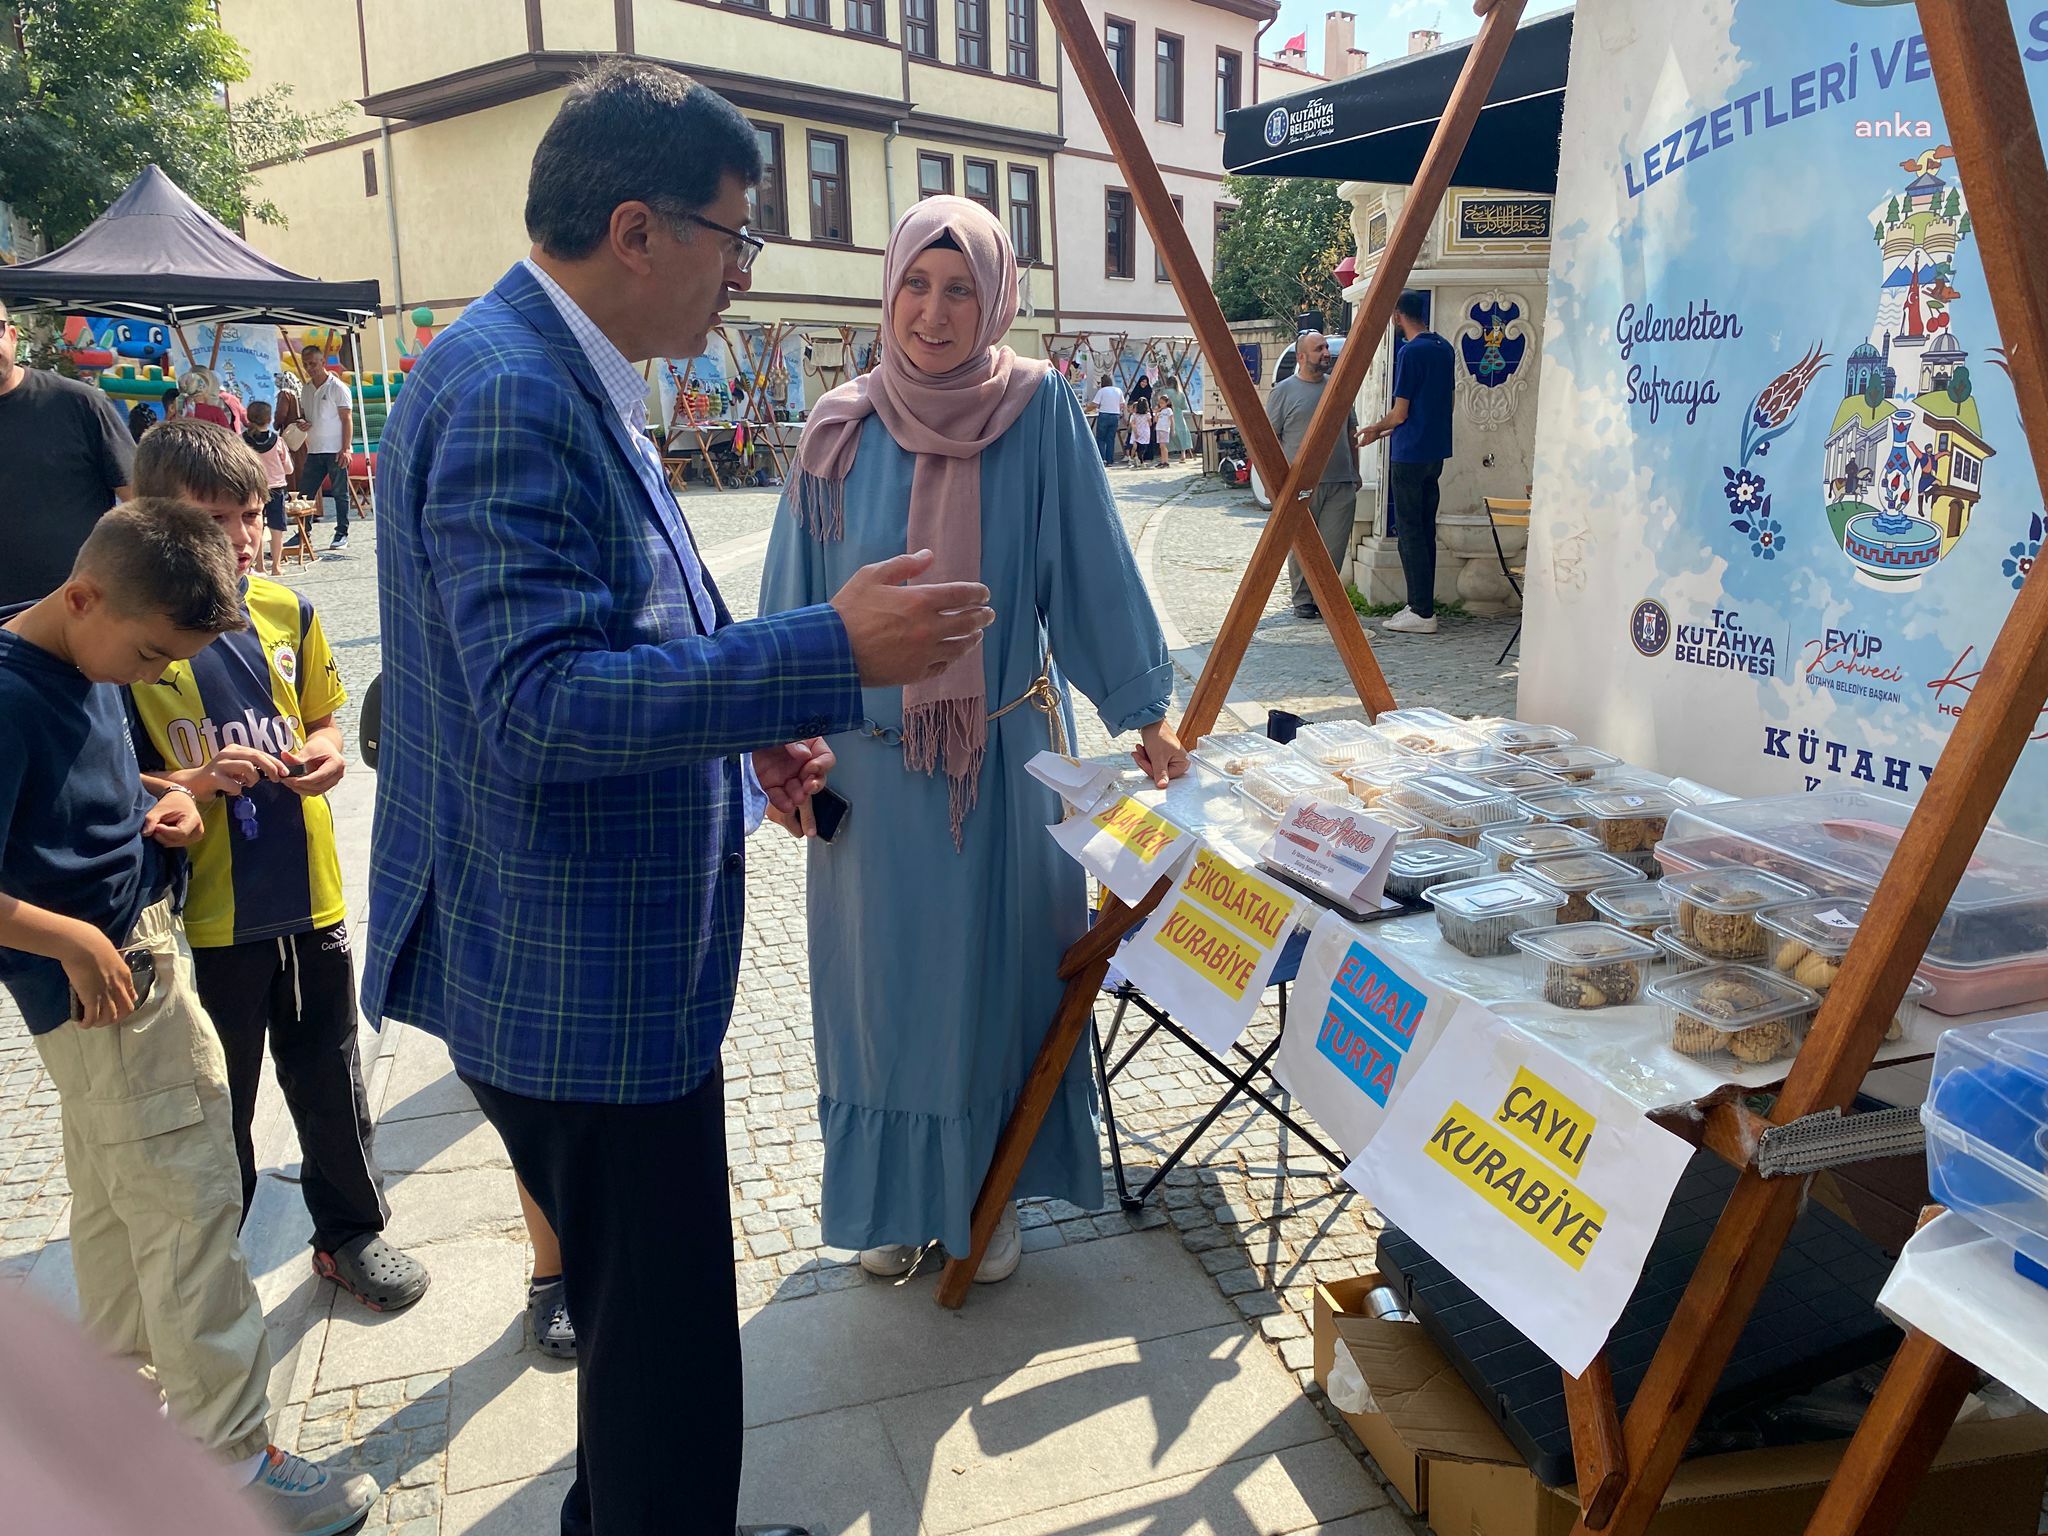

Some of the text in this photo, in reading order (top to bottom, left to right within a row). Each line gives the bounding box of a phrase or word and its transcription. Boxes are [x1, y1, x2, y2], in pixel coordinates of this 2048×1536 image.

[1290, 115, 1334, 136] BELEDİYESİ
[1624, 42, 1859, 199] LEZZETLERİ
[1871, 34, 1932, 90] VE
[1616, 299, 1743, 360] Gelenekten
[1627, 364, 1720, 425] Sofraya
[1712, 609, 1743, 631] T.C.
[1825, 628, 1883, 659] EYÜP
[1675, 644, 1775, 676] BELEDİYESİ
[1804, 639, 1902, 682] Kahveci
[1805, 673, 1901, 704] KÜTAHYA BELEDİYE BAŞKANI
[1131, 825, 1174, 856] KEK
[1183, 860, 1289, 938] ÇİKOLATALI
[1160, 911, 1257, 991] KURABİYE
[1336, 956, 1423, 1038] ELMALI
[1321, 1011, 1394, 1096] TURTA
[1498, 1085, 1592, 1165] ÇAYLI
[1430, 1116, 1603, 1257] KURABİYE
